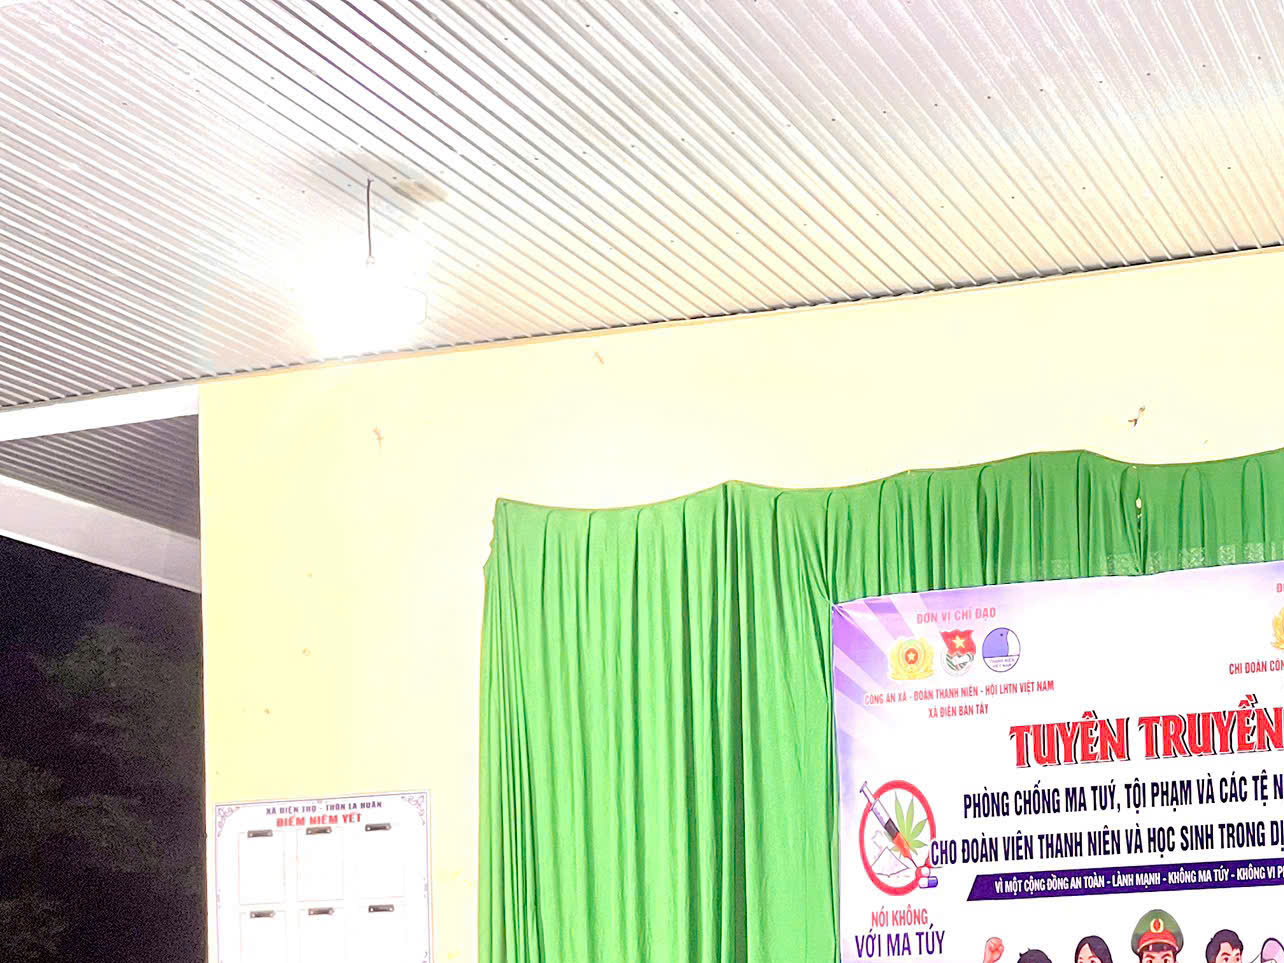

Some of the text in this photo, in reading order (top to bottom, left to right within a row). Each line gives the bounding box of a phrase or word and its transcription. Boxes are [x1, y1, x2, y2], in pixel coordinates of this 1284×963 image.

[1229, 662, 1243, 675] CHI
[1245, 659, 1267, 674] ĐOÀN
[1036, 680, 1055, 692] NAM
[1008, 710, 1131, 768] TUYÊN
[963, 786, 1010, 818] PHÒNG
[1014, 780, 1060, 816] CHỐNG
[1065, 787, 1087, 812] MA
[1091, 779, 1121, 813] TUÝ,
[1124, 778, 1146, 814] TỘI
[1151, 780, 1192, 812] PHẠM
[1197, 773, 1215, 804] VÀ
[1219, 771, 1248, 803] CÁC
[1252, 769, 1268, 806] TỆ
[930, 839, 957, 866] CHO
[961, 833, 998, 864] ĐOÀN
[1002, 830, 1033, 861] VIÊN
[1038, 832, 1083, 859] THANH
[1087, 825, 1120, 856] NIÊN
[1125, 823, 1143, 854] VÀ
[1148, 826, 1176, 858] HỌC
[1181, 824, 1214, 851] SINH
[1218, 821, 1265, 848] TRONG
[994, 878, 1003, 893] VÌ
[1005, 876, 1022, 895] MỘT
[1024, 875, 1046, 894] CỘNG
[1047, 874, 1069, 891] ĐỒNG
[1070, 876, 1082, 889] AN
[1083, 872, 1104, 888] TOÀN
[1112, 871, 1134, 887] LÀNH
[1136, 872, 1161, 888] MẠNH
[1168, 866, 1196, 884] KHÔNG
[1198, 869, 1212, 882] MA
[1213, 865, 1229, 881] TÚY
[1237, 863, 1265, 880] KHÔNG
[1266, 866, 1275, 879] VI
[871, 904, 928, 927] NÓI KHÔNG
[855, 923, 945, 958] VỚI MA TÚY
